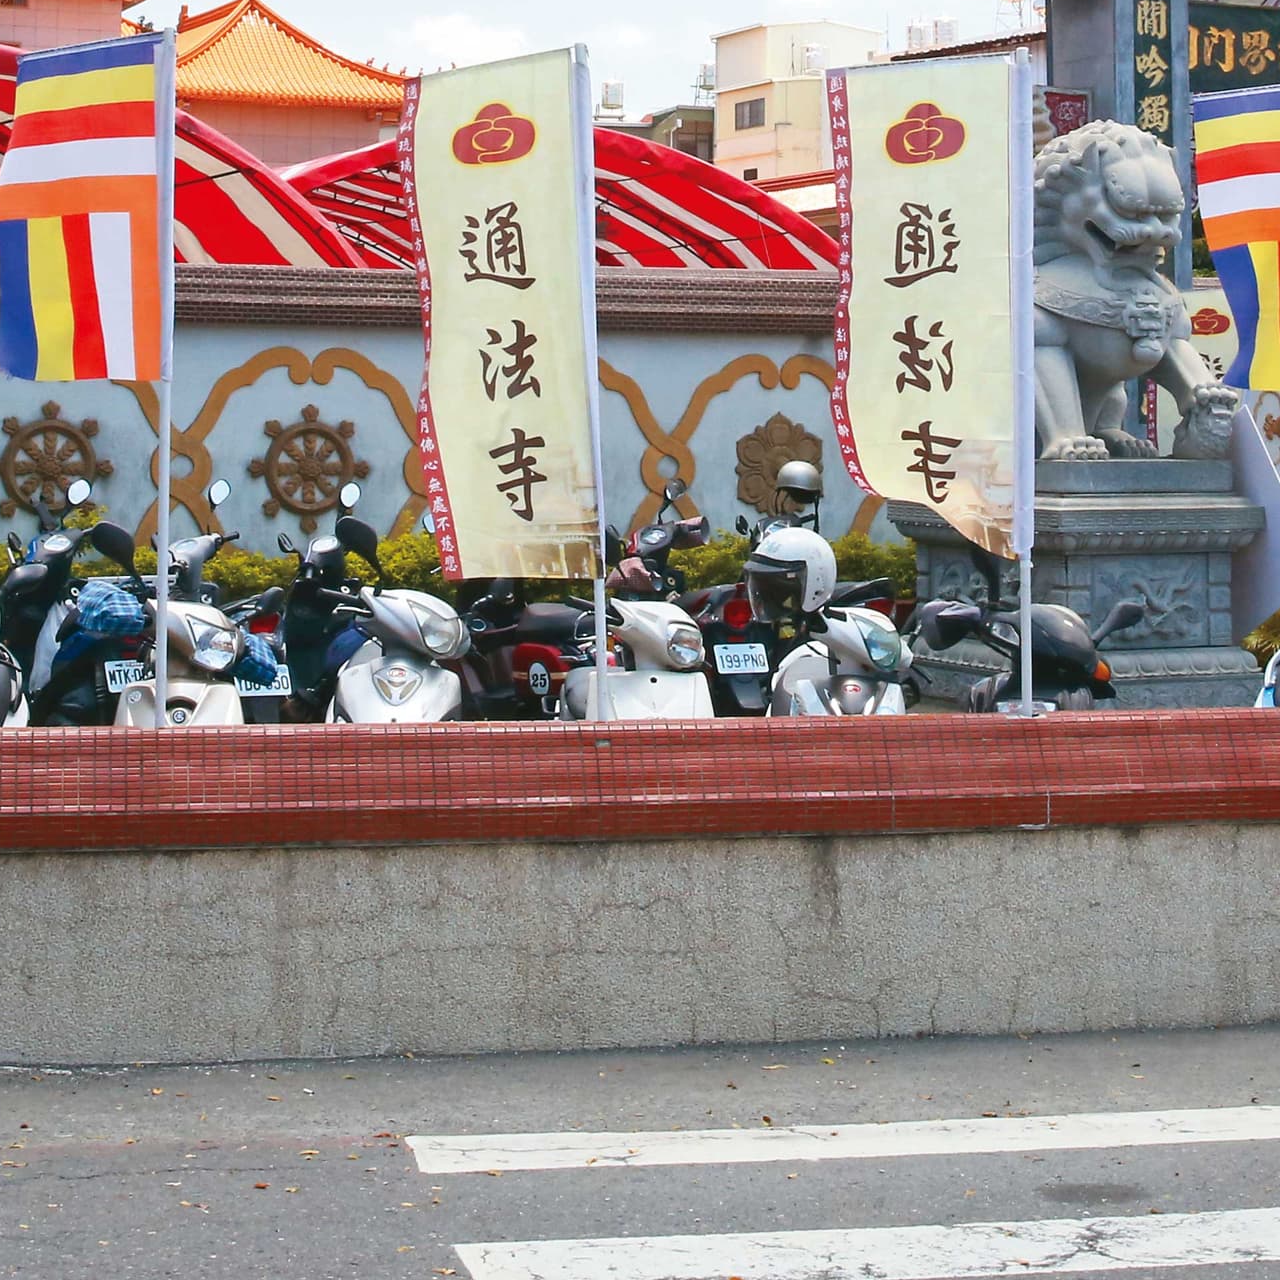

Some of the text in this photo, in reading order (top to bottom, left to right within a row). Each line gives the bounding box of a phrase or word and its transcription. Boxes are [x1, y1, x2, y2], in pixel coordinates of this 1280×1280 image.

[457, 201, 549, 523] 通法寺
[531, 673, 547, 688] 25
